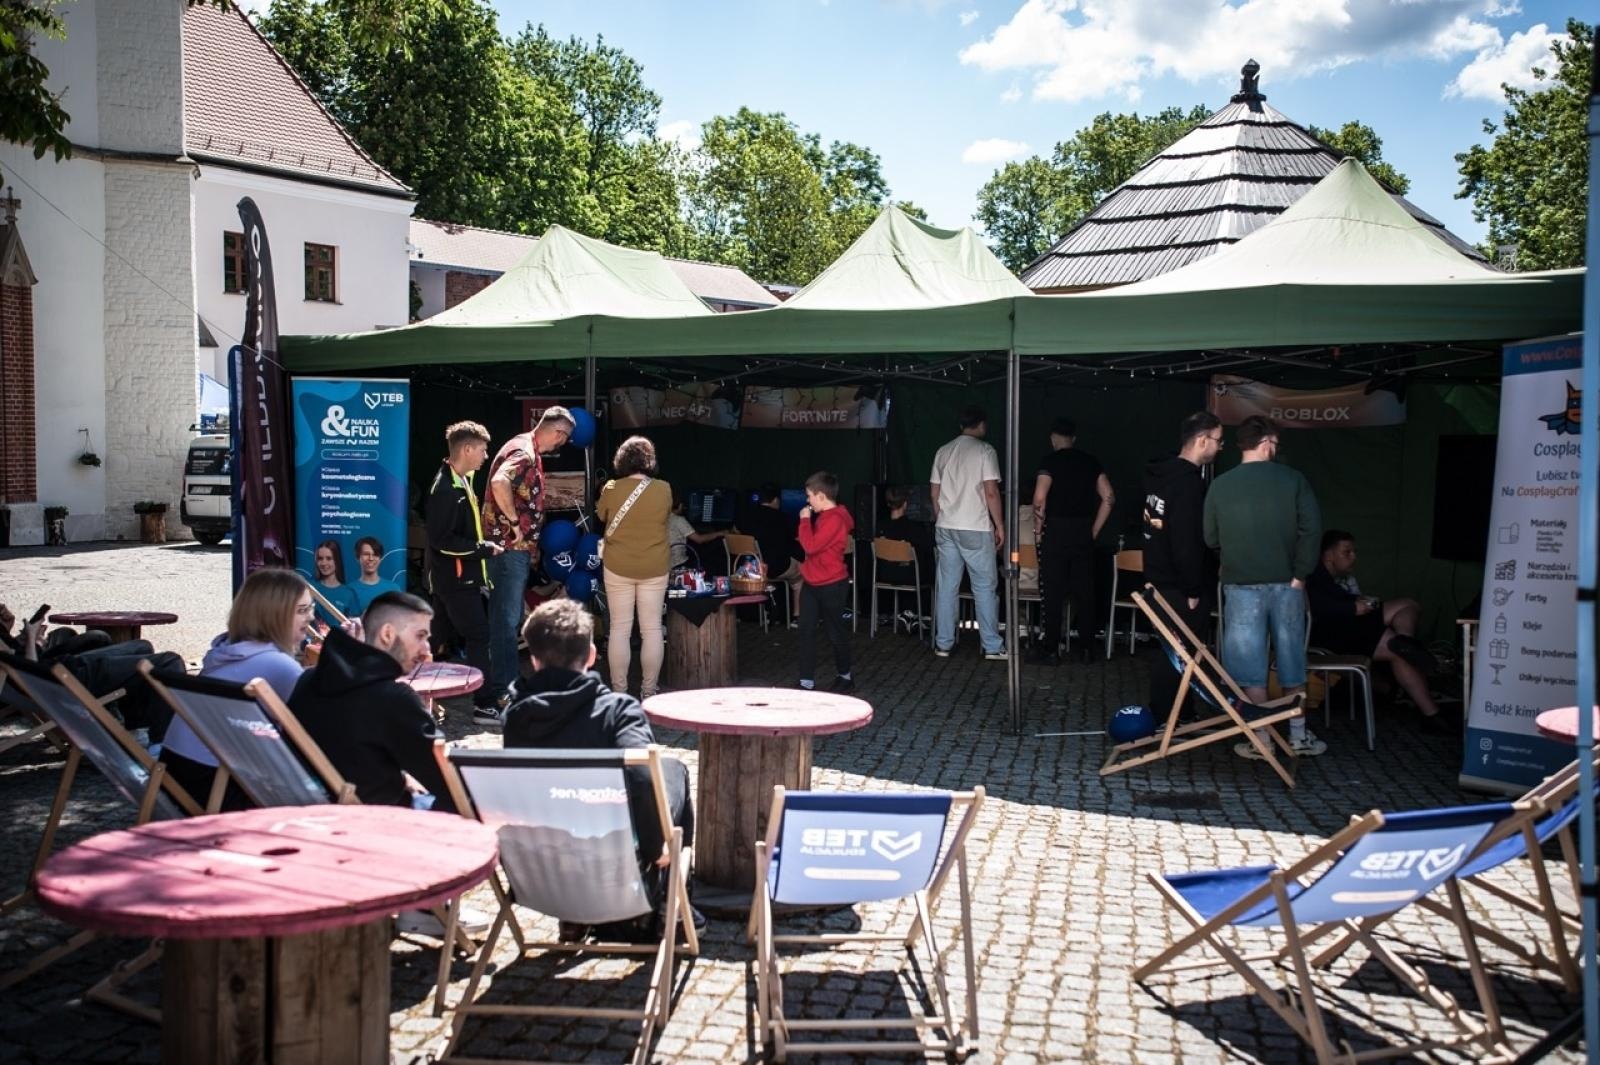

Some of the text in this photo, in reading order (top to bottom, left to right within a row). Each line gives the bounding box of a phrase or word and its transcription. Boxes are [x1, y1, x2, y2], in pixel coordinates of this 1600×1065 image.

[381, 393, 404, 403] TEB
[783, 410, 849, 423] FORTNITE
[1270, 406, 1351, 421] ROBLOX
[321, 405, 350, 437] &
[351, 426, 380, 437] FUN
[1536, 470, 1568, 481] Lubisz
[1501, 487, 1515, 497] Na
[1525, 593, 1547, 604] Farby
[1523, 621, 1542, 631] Kleje
